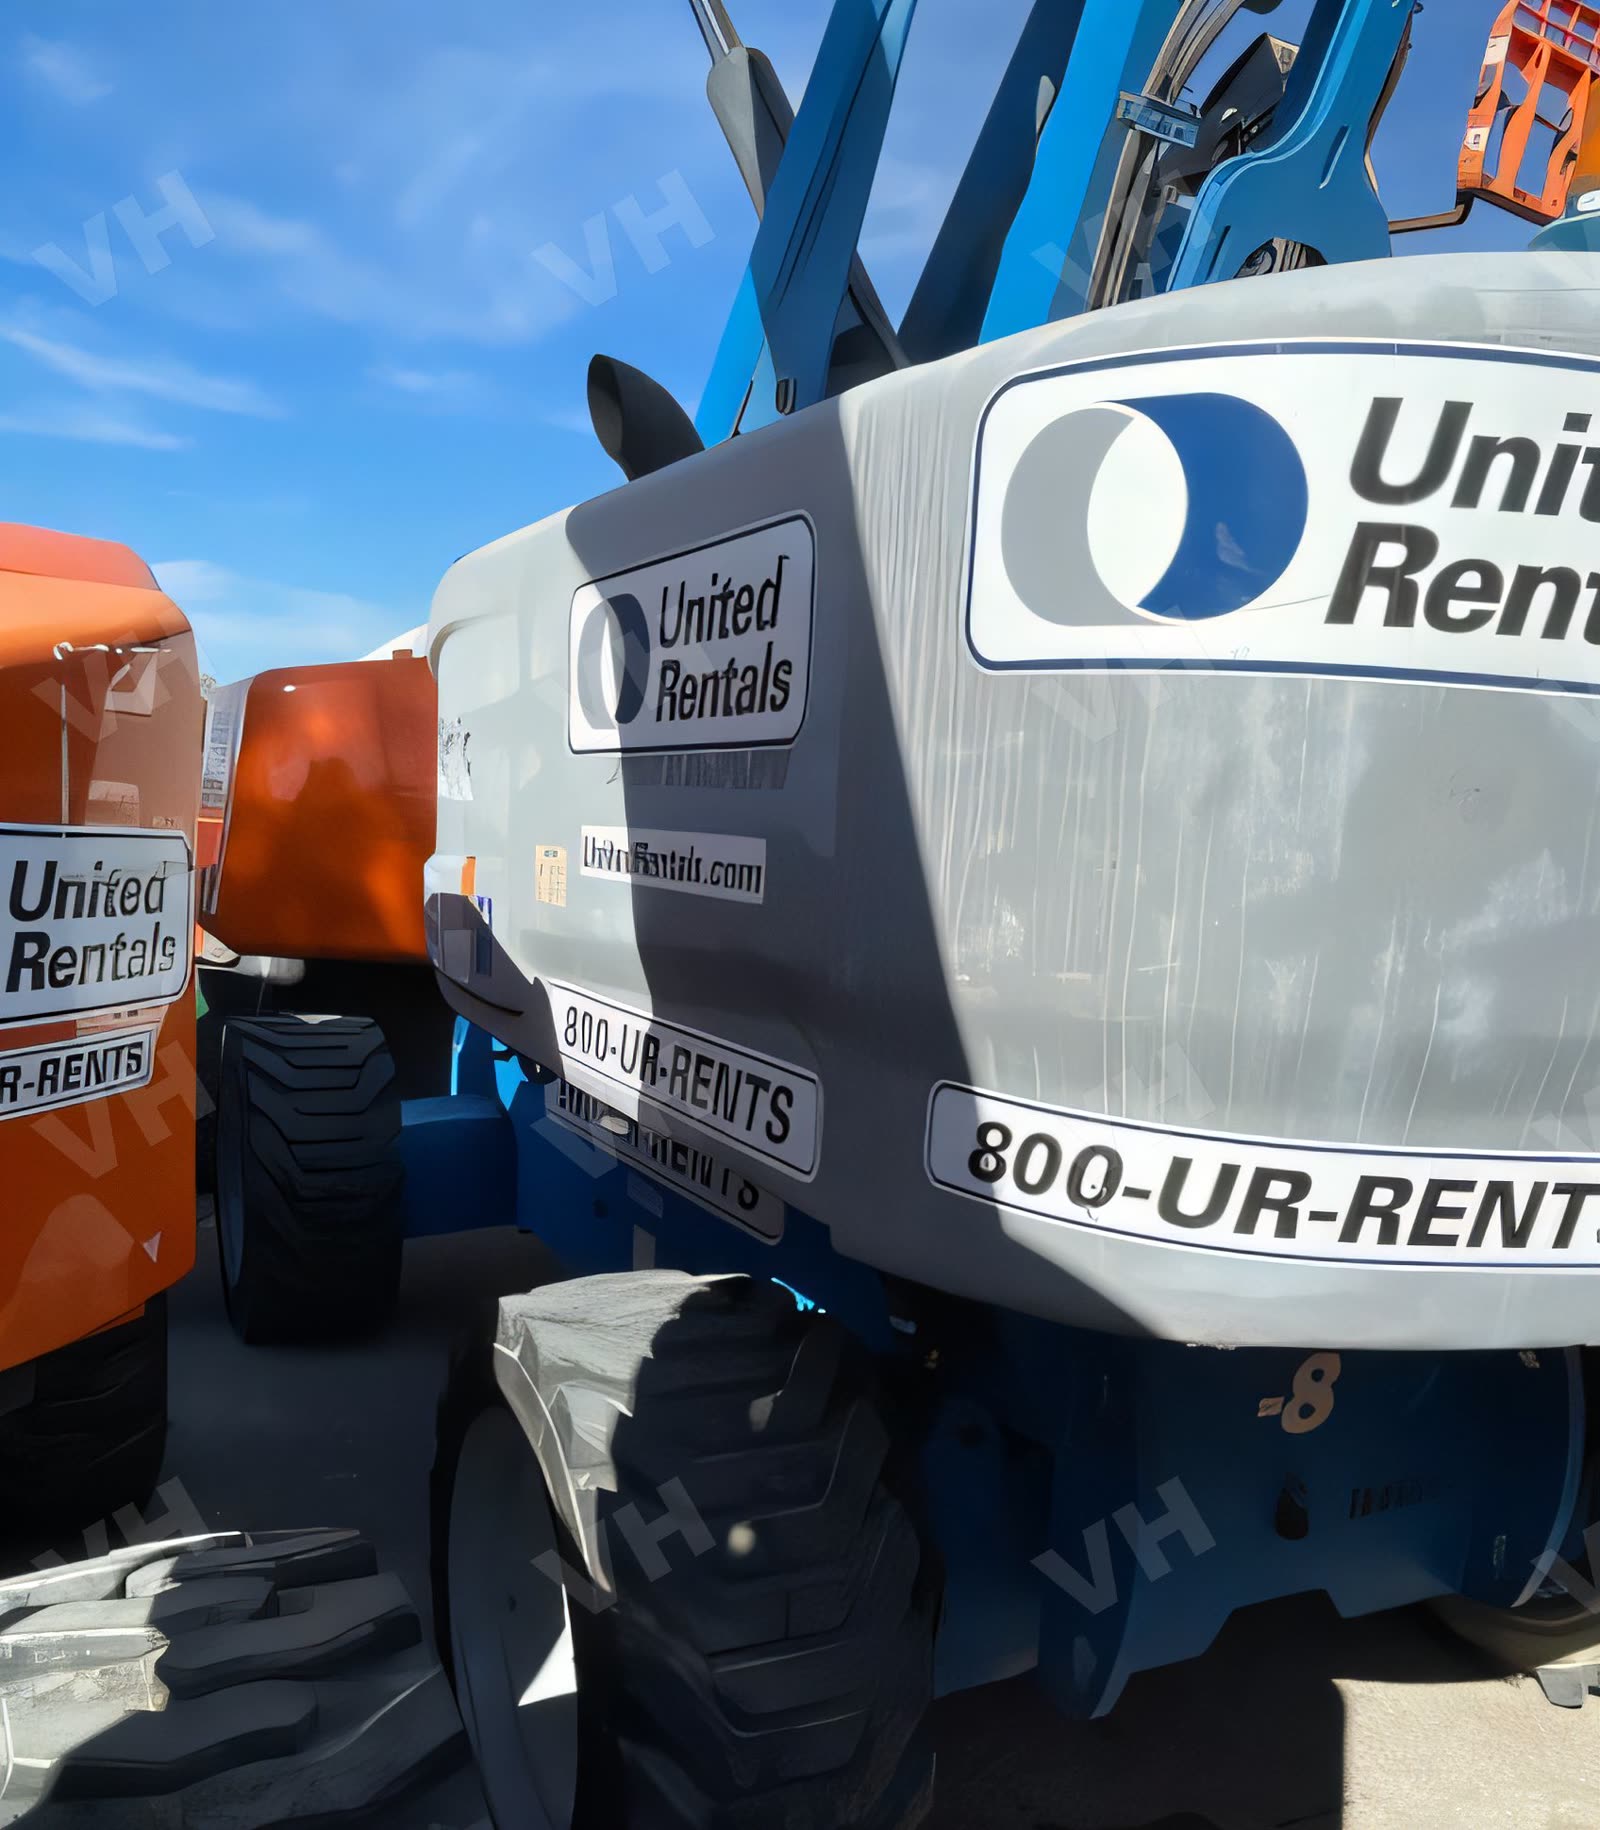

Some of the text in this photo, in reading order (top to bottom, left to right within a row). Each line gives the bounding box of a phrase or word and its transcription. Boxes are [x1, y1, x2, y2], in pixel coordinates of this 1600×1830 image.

[660, 555, 790, 648] United
[656, 641, 792, 722] Rentals
[5, 921, 176, 993] Rentals
[968, 1121, 1600, 1250] 800-UR-RENT
